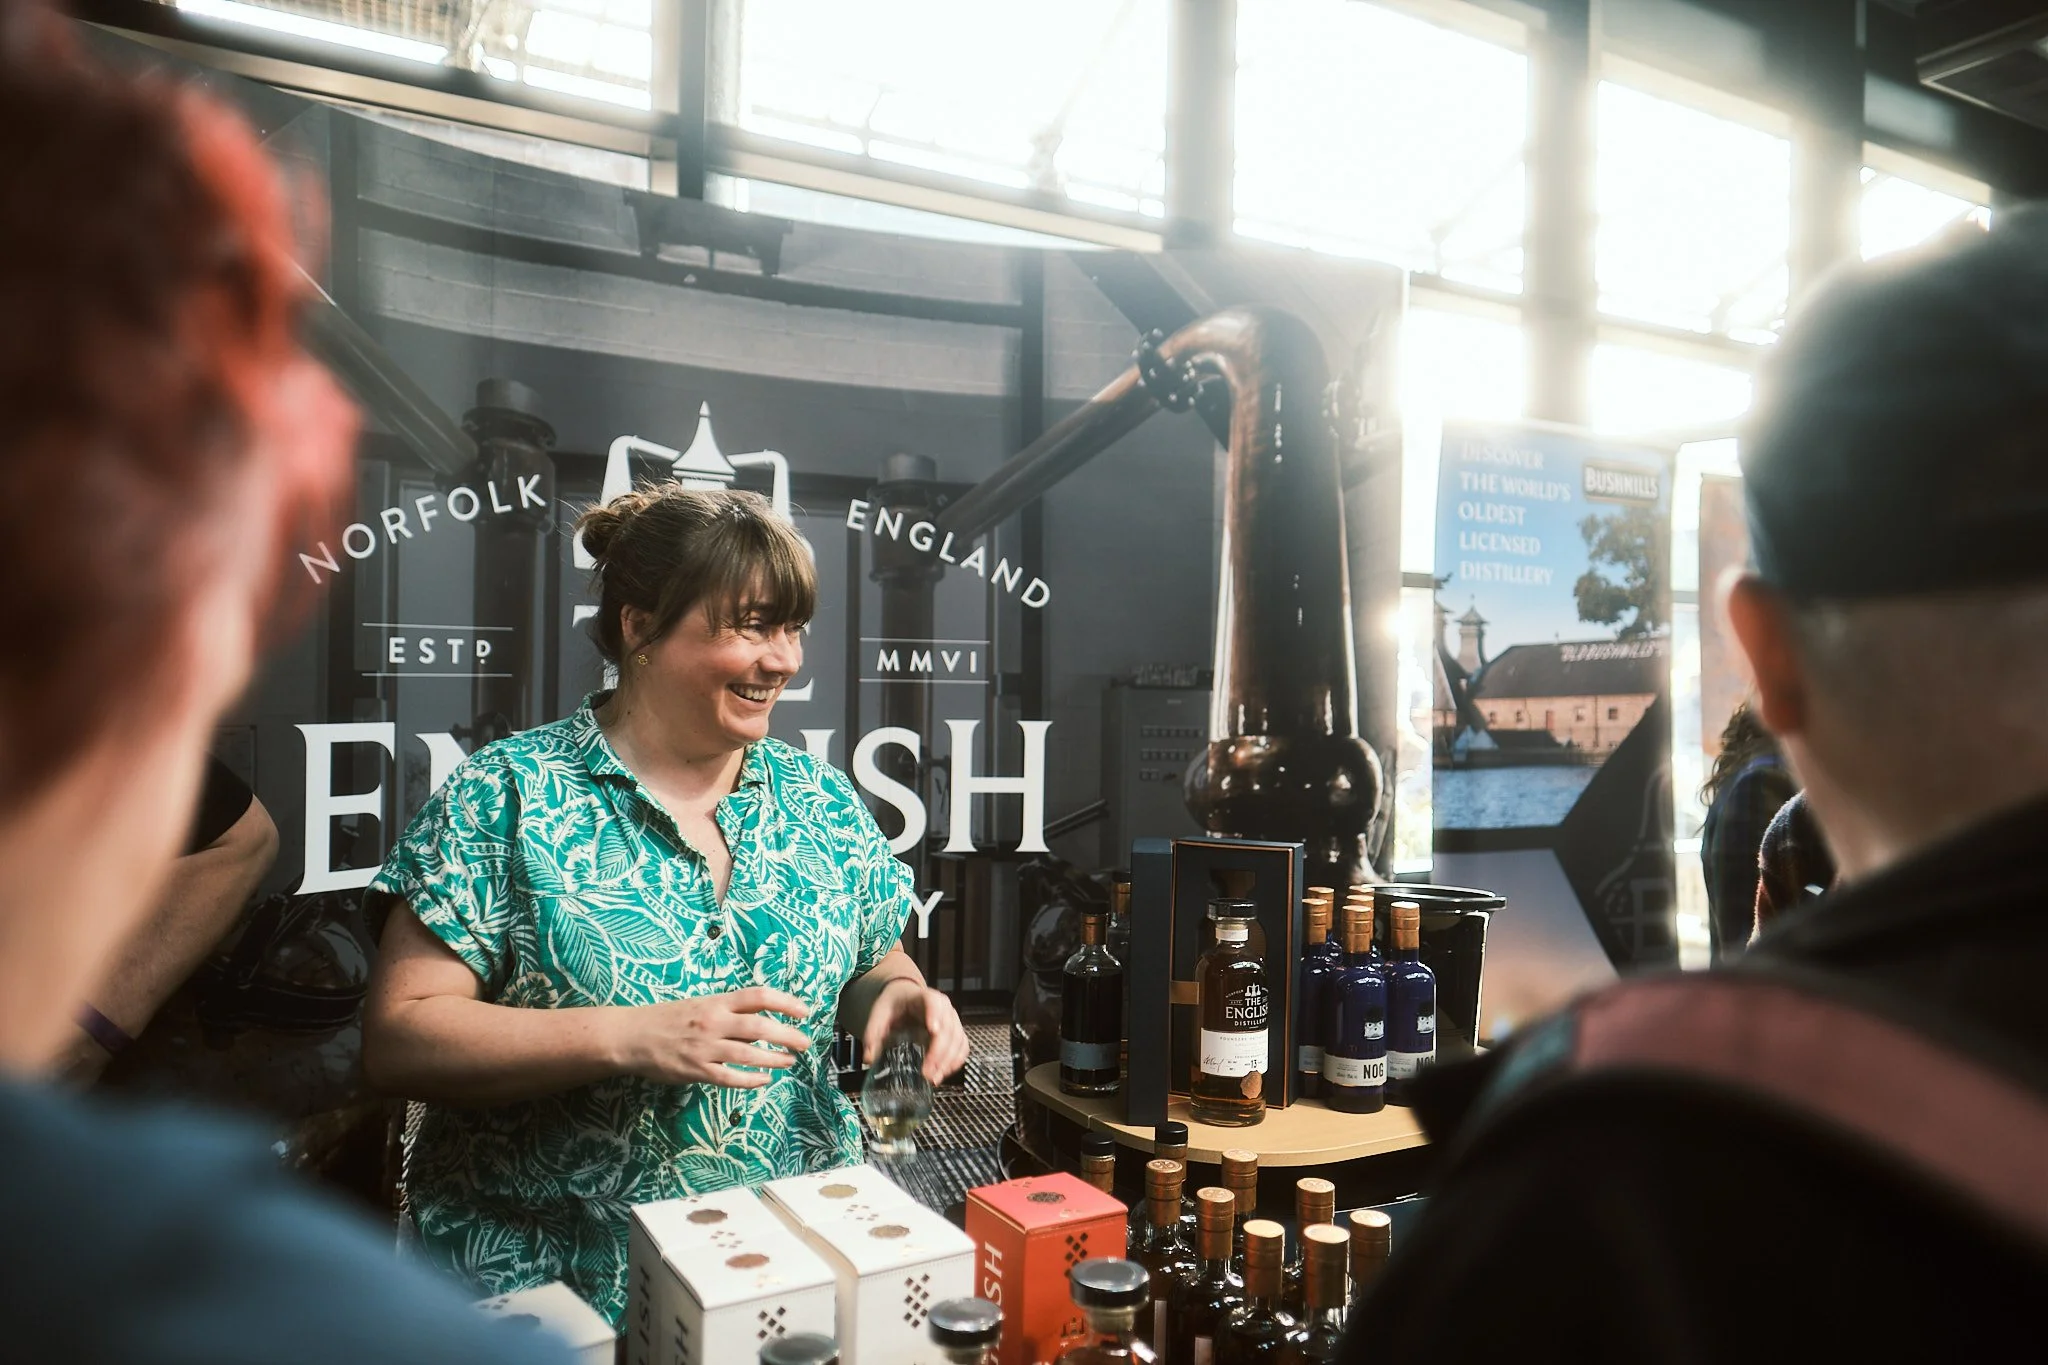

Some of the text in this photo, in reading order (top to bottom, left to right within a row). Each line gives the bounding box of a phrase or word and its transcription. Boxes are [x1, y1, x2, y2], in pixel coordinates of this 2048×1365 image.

[1461, 440, 1544, 470] DISCOVER
[1459, 471, 1571, 502] THE WORLD'S
[1584, 467, 1658, 499] BUSHMILLS
[1457, 501, 1526, 526] OLDEST
[298, 473, 546, 585] NORFOLK
[846, 498, 1051, 609] ENGLAND
[1459, 531, 1541, 556] LICENSED
[1459, 561, 1553, 586] DISTILLERY
[877, 650, 977, 674] MMVI
[1244, 997, 1261, 1007] THE
[1250, 1059, 1257, 1069] 13
[1363, 1062, 1384, 1079] NOG
